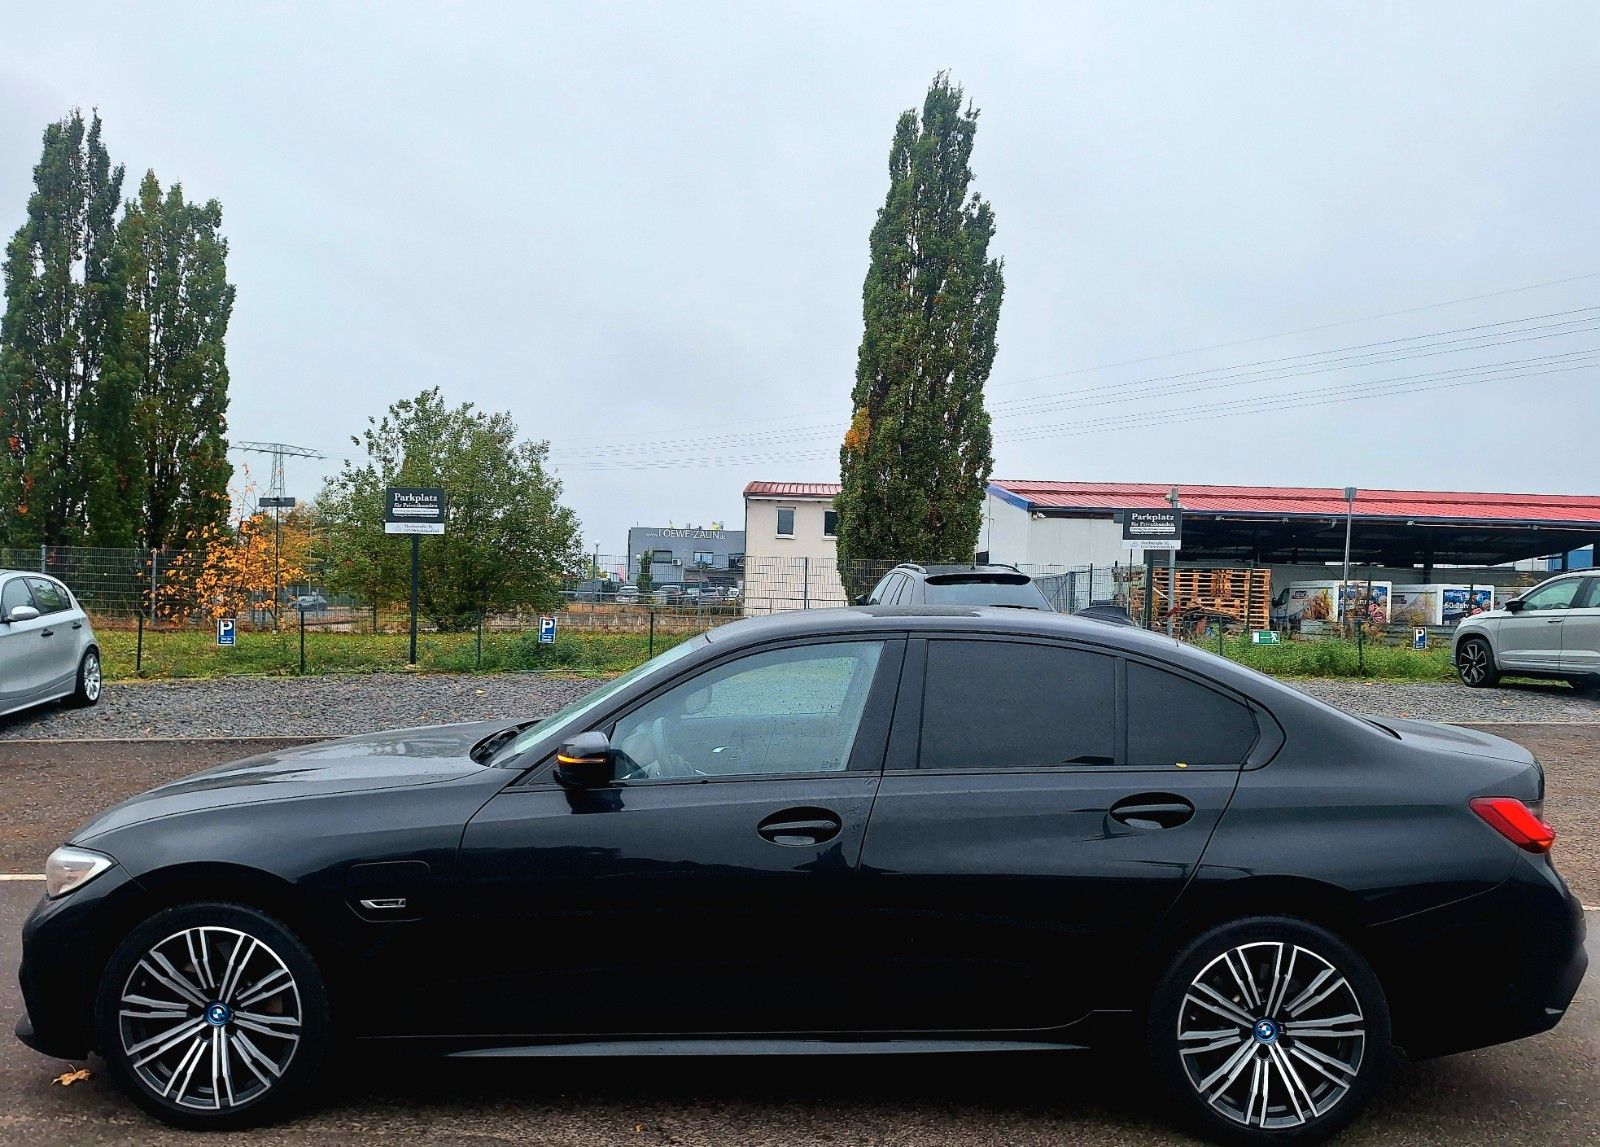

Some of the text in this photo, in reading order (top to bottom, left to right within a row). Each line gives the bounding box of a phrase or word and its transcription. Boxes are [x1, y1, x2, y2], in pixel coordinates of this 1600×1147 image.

[394, 492, 438, 503] Parkplatz
[1131, 512, 1175, 523] Parkplatz
[220, 620, 232, 635] P
[542, 619, 553, 633] P
[1415, 628, 1424, 641] P
